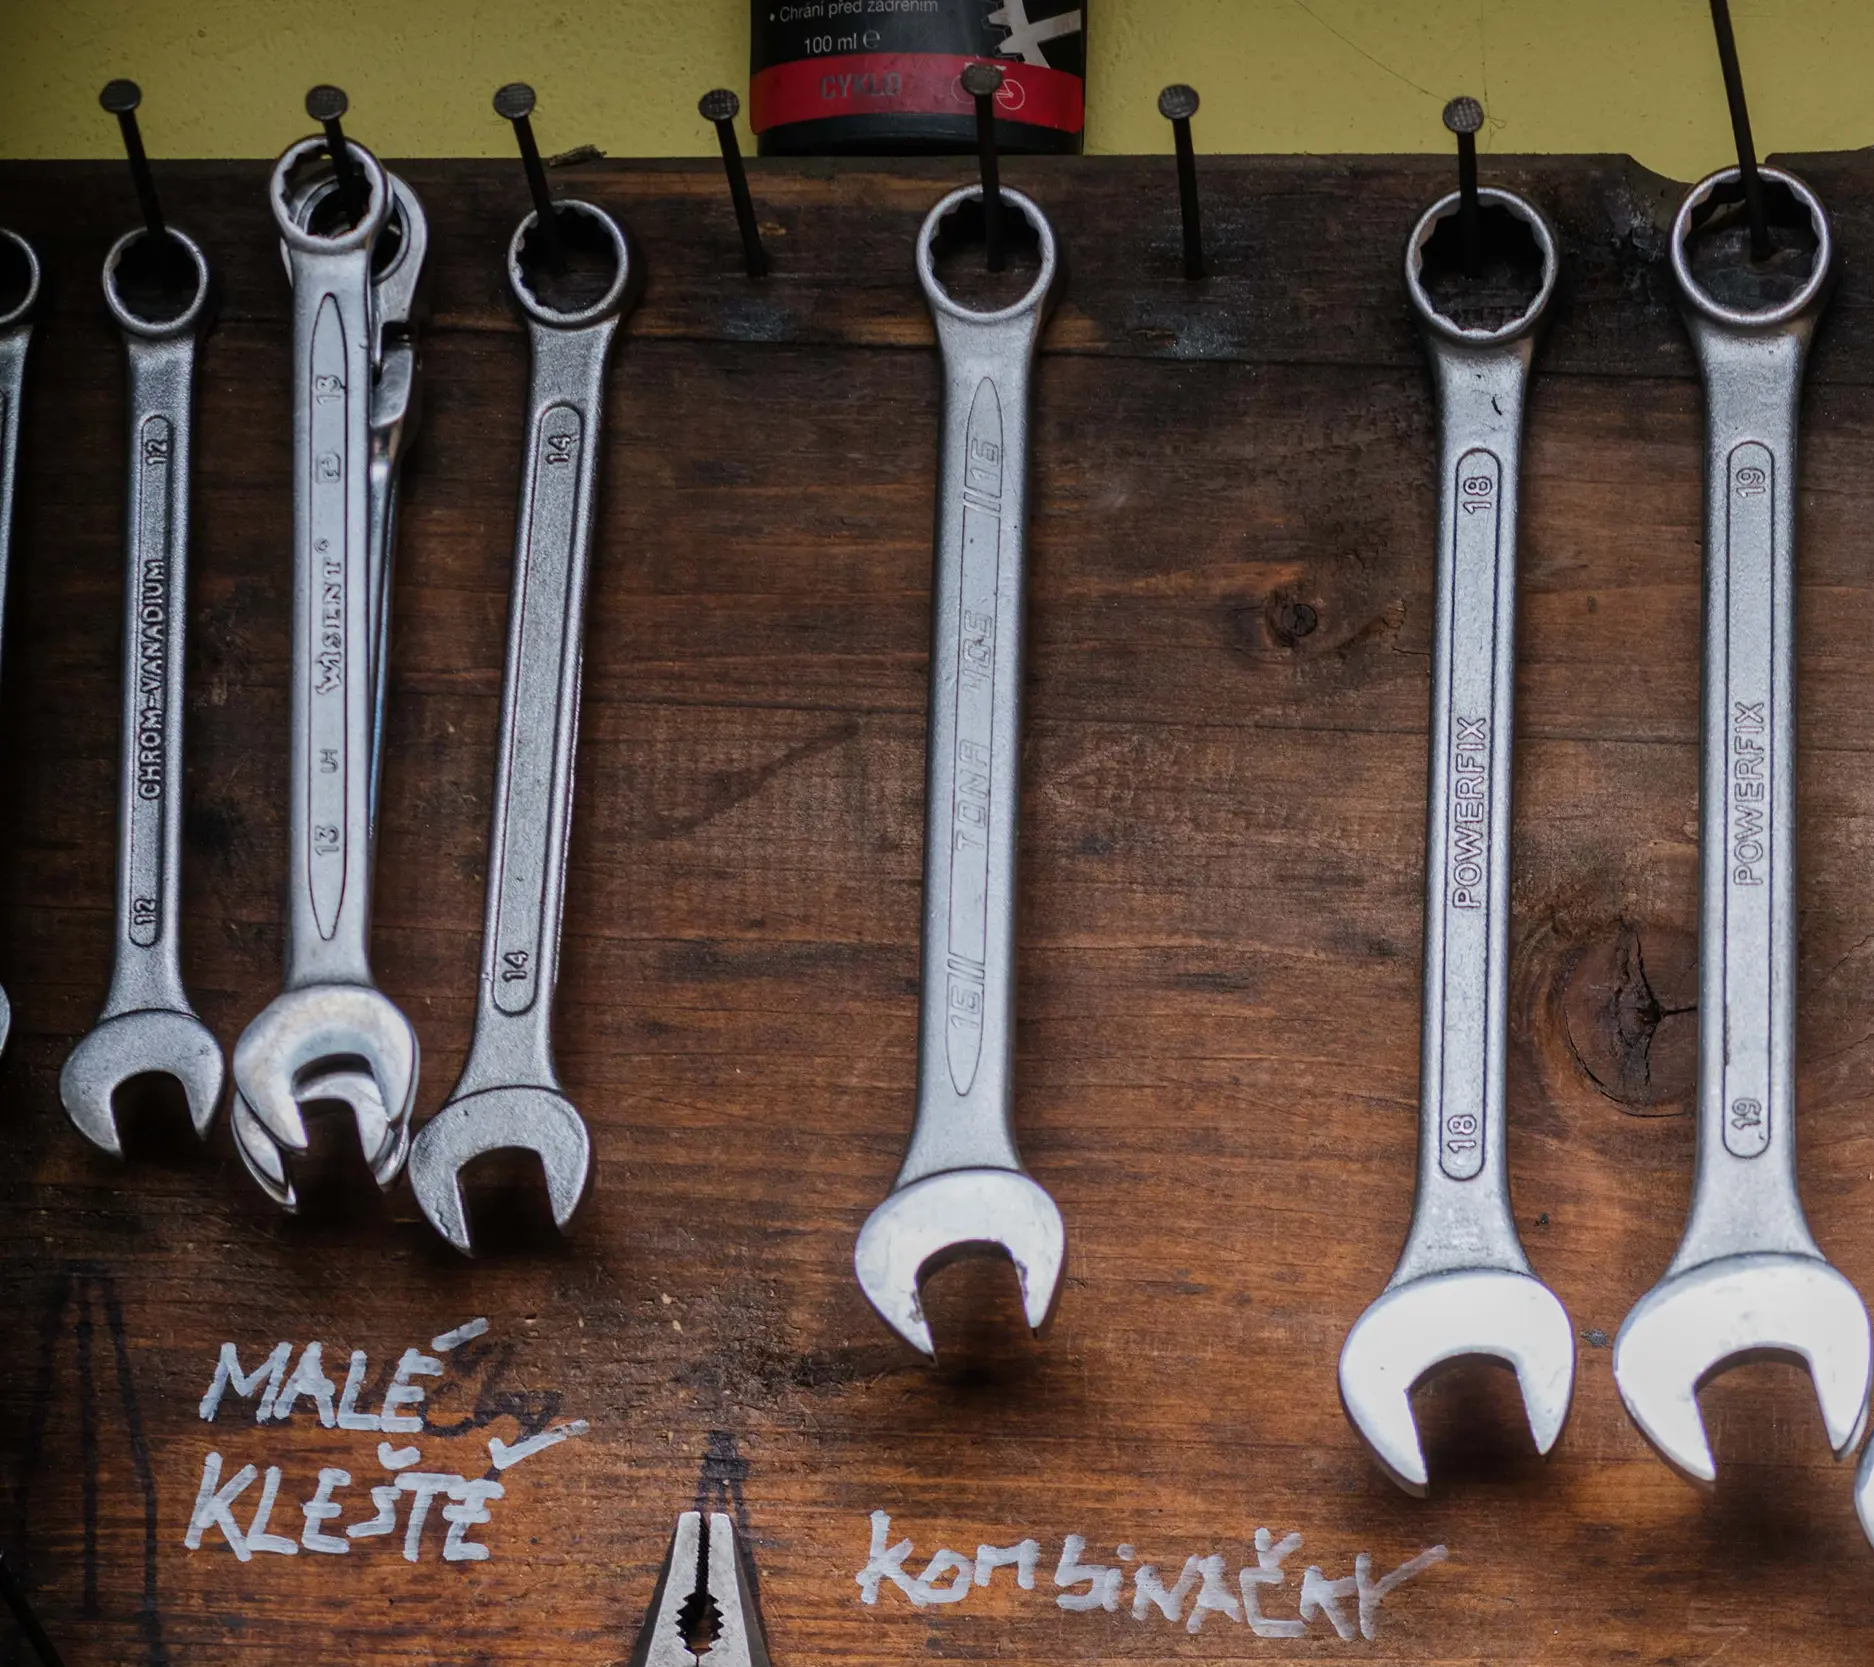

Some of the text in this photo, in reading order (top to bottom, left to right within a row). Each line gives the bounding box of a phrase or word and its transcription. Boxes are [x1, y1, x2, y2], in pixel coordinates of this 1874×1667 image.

[804, 35, 832, 55] 100
[837, 33, 857, 50] ml
[820, 72, 900, 99] CYKLO
[314, 373, 343, 405] 13
[145, 438, 168, 466] 12
[547, 434, 573, 465] 14
[1462, 475, 1493, 514] 18
[1736, 467, 1765, 499] 19
[139, 559, 166, 800] CHROM-VANADIUM
[955, 739, 990, 852] TONA
[1733, 701, 1765, 887] POWERFIX
[1453, 717, 1487, 909] POWERFIX
[314, 825, 340, 857] 13
[134, 899, 156, 926] 12
[502, 951, 528, 983] 14
[1732, 1096, 1762, 1132] 19
[1446, 1114, 1477, 1155] 18
[199, 1316, 490, 1434] MALÉ
